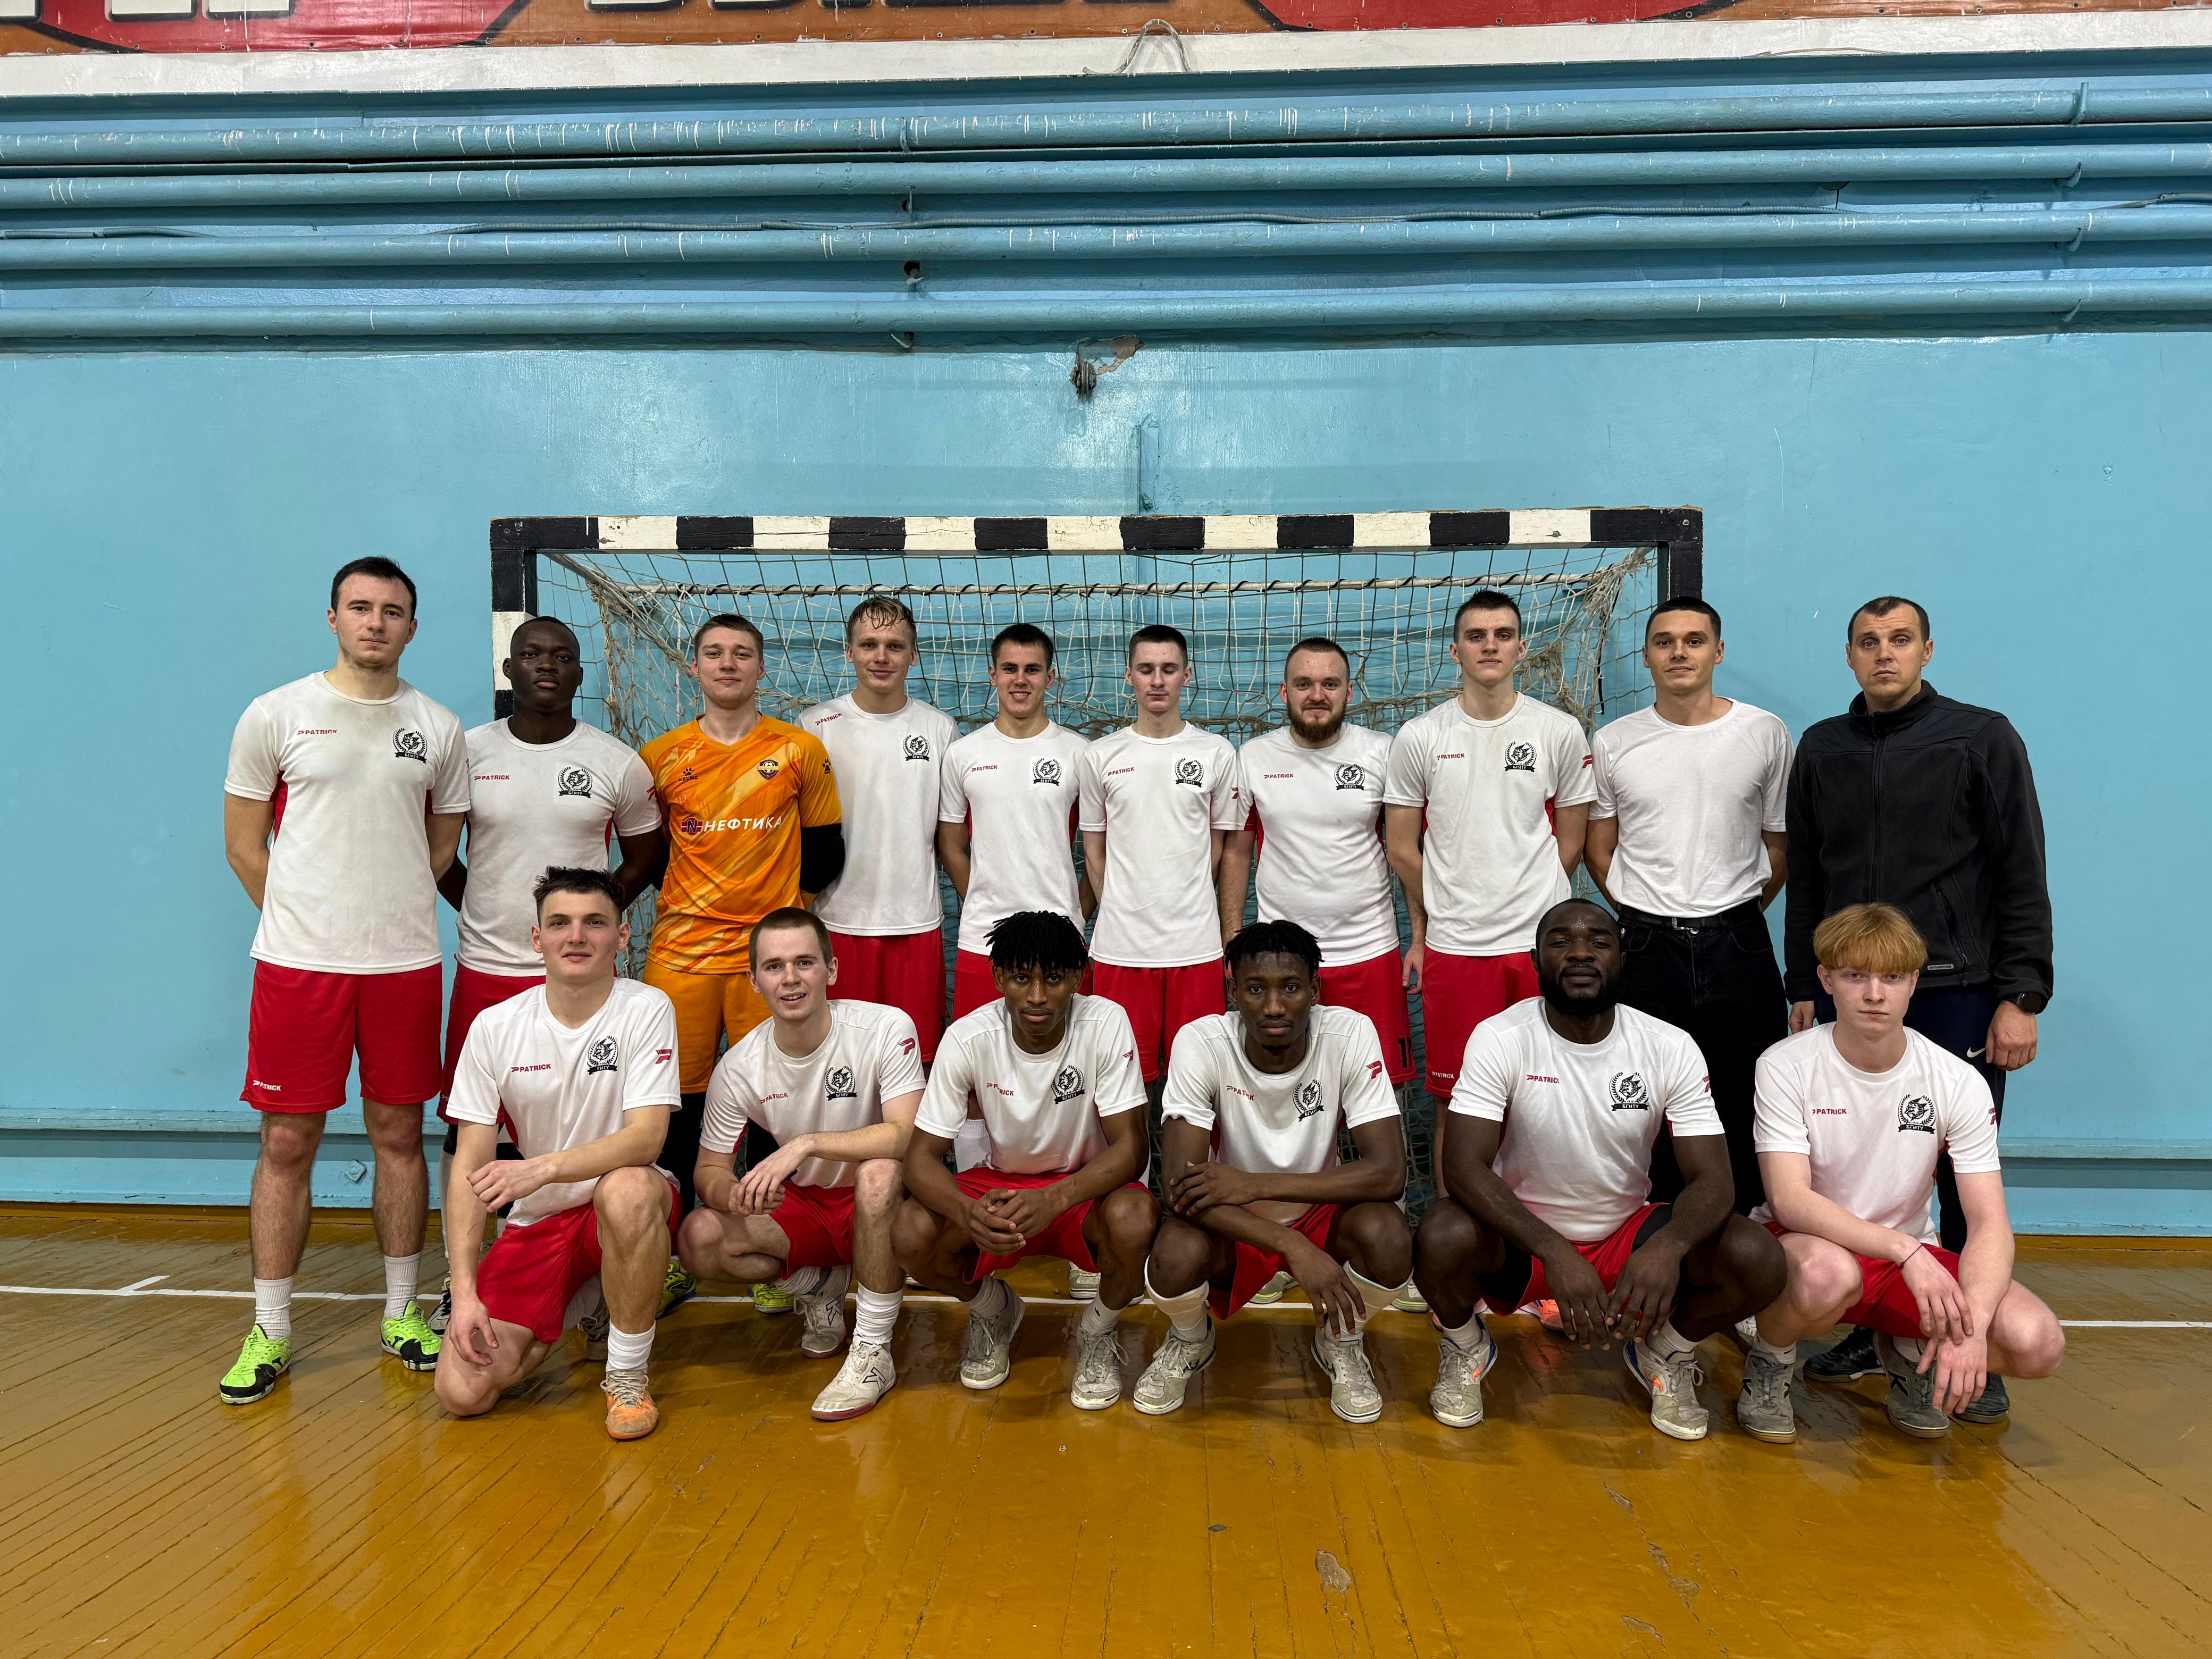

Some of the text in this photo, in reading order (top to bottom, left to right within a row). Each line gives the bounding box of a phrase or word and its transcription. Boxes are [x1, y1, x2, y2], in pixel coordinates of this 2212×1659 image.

[820, 713, 842, 723] PATRICK
[1112, 767, 1135, 775] PATRICK
[703, 816, 782, 832] НЕФТИКА
[520, 1063, 551, 1072] PATRICK
[994, 1084, 1014, 1096] PRICK
[766, 1093, 789, 1102] PATRICK
